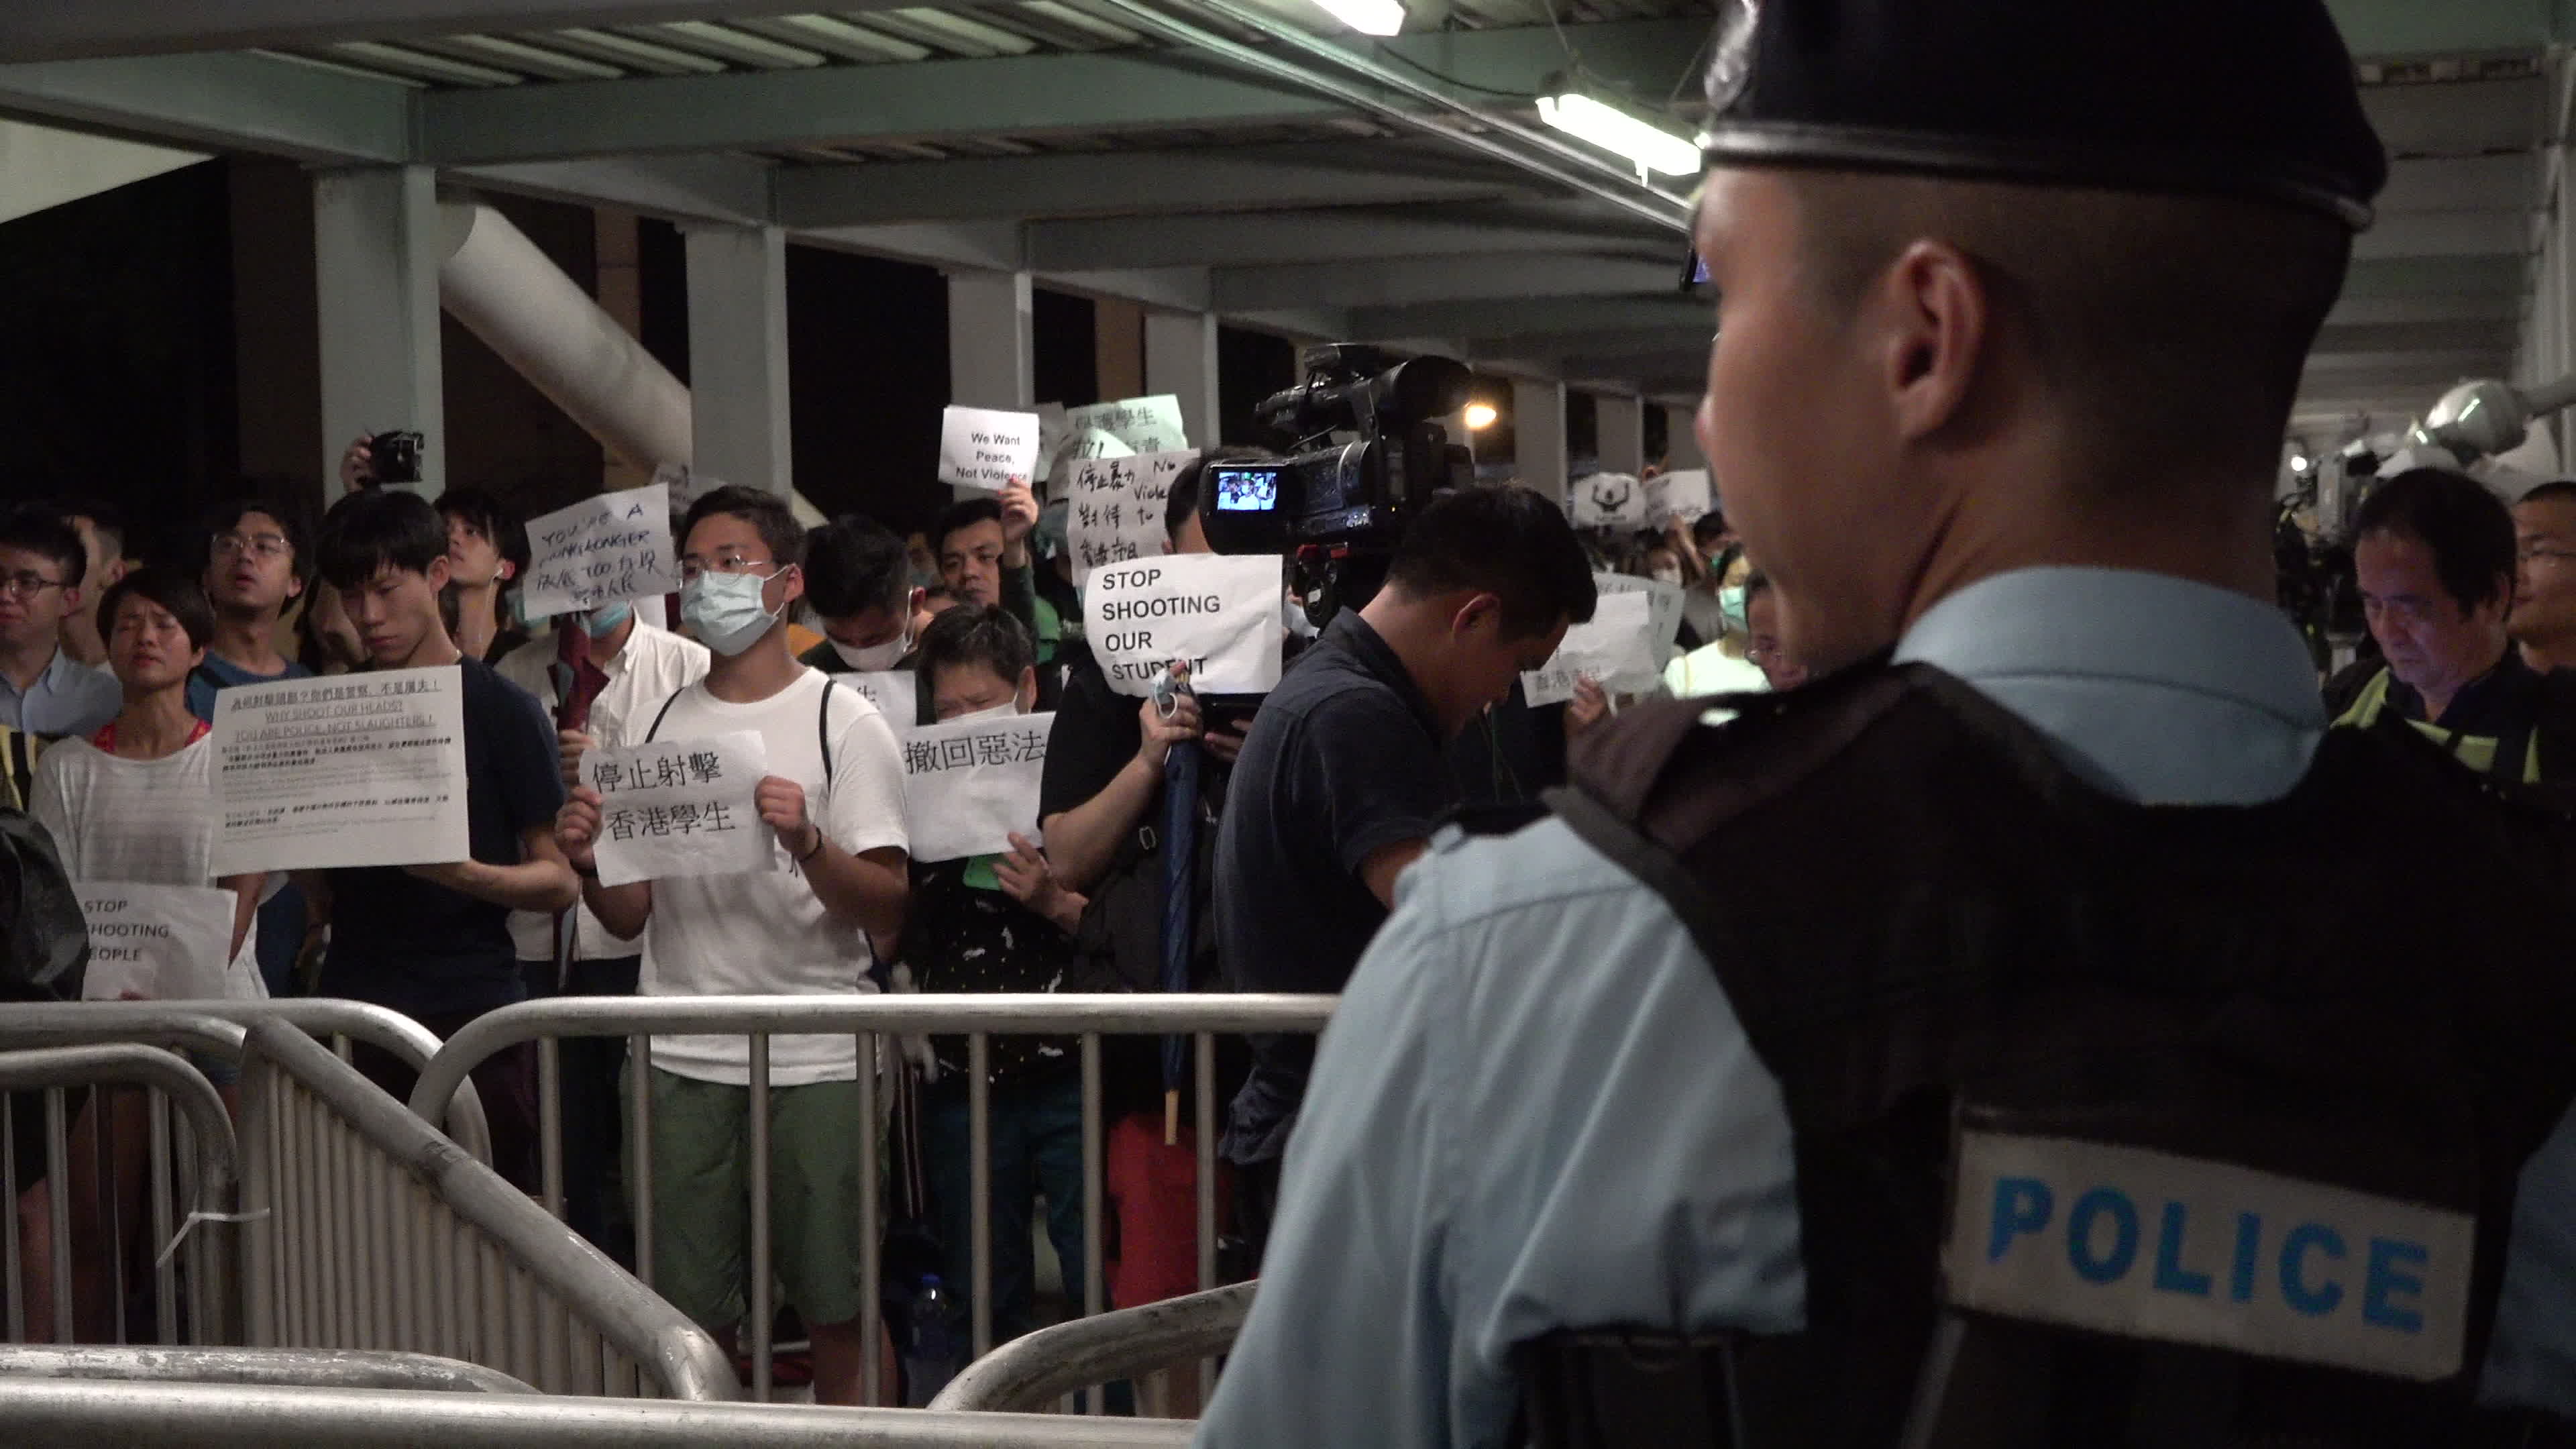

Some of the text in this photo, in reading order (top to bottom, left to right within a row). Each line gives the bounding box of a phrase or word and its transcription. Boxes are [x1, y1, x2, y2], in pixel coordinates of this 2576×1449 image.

[971, 432, 1020, 445] We Want
[976, 450, 1014, 467] Peace,
[1153, 459, 1176, 476] No
[955, 466, 977, 478] Not
[1102, 569, 1162, 590] STOP
[1102, 594, 1221, 621] SHOOTING
[1105, 631, 1152, 652] OUR
[265, 708, 290, 724] WHY
[292, 704, 331, 722] SHOOT
[335, 703, 357, 718] OUR
[258, 726, 281, 740] ARE
[327, 720, 352, 735] NOT
[903, 729, 1046, 775] 撤回惡法
[592, 750, 722, 794] 停止射擊
[606, 800, 737, 841] 香港學生
[84, 900, 128, 913] STOP
[91, 923, 169, 939] HOOTING
[91, 947, 142, 961] EOPLE
[1986, 1176, 2430, 1334] POLICE
